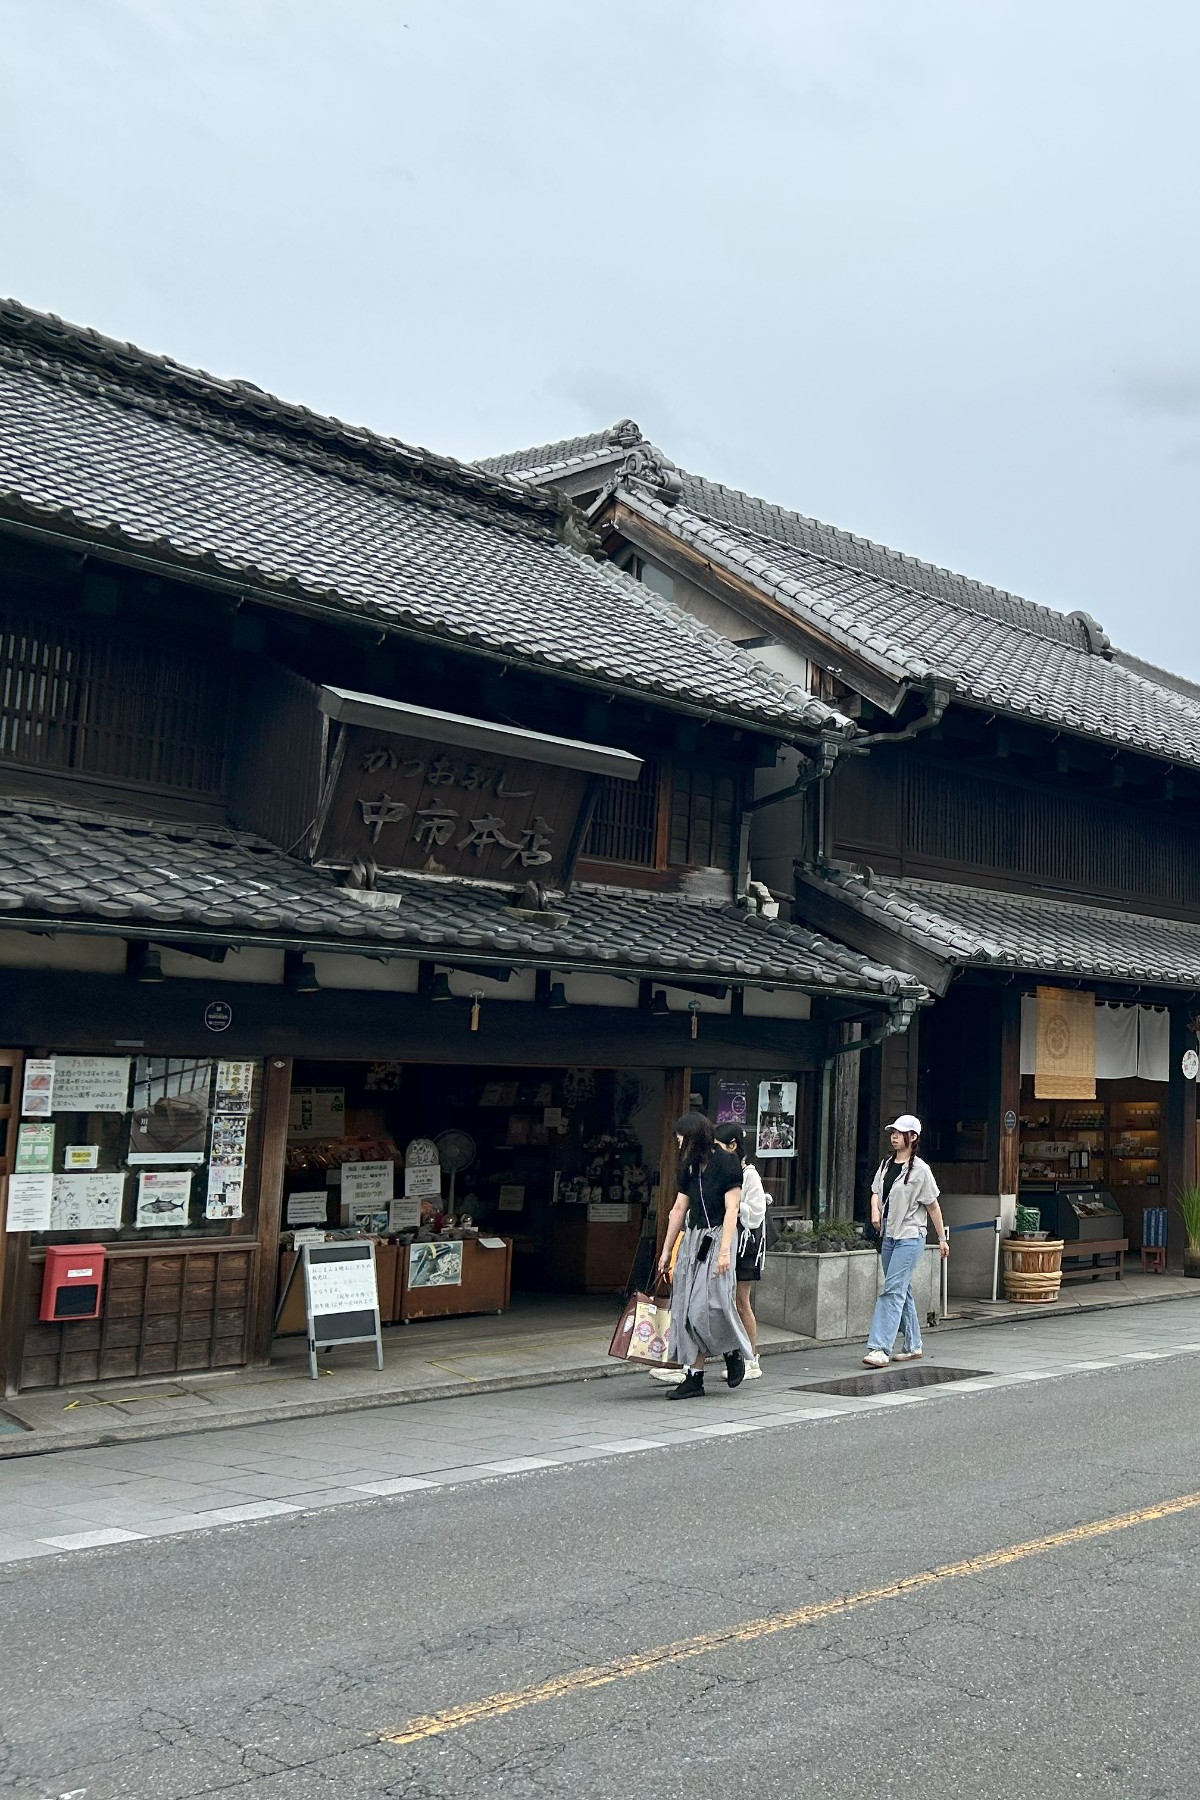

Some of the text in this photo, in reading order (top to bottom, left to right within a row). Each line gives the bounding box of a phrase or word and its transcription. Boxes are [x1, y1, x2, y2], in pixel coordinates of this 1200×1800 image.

[360, 747, 534, 799] かつおぶし
[356, 792, 556, 870] 中市本店
